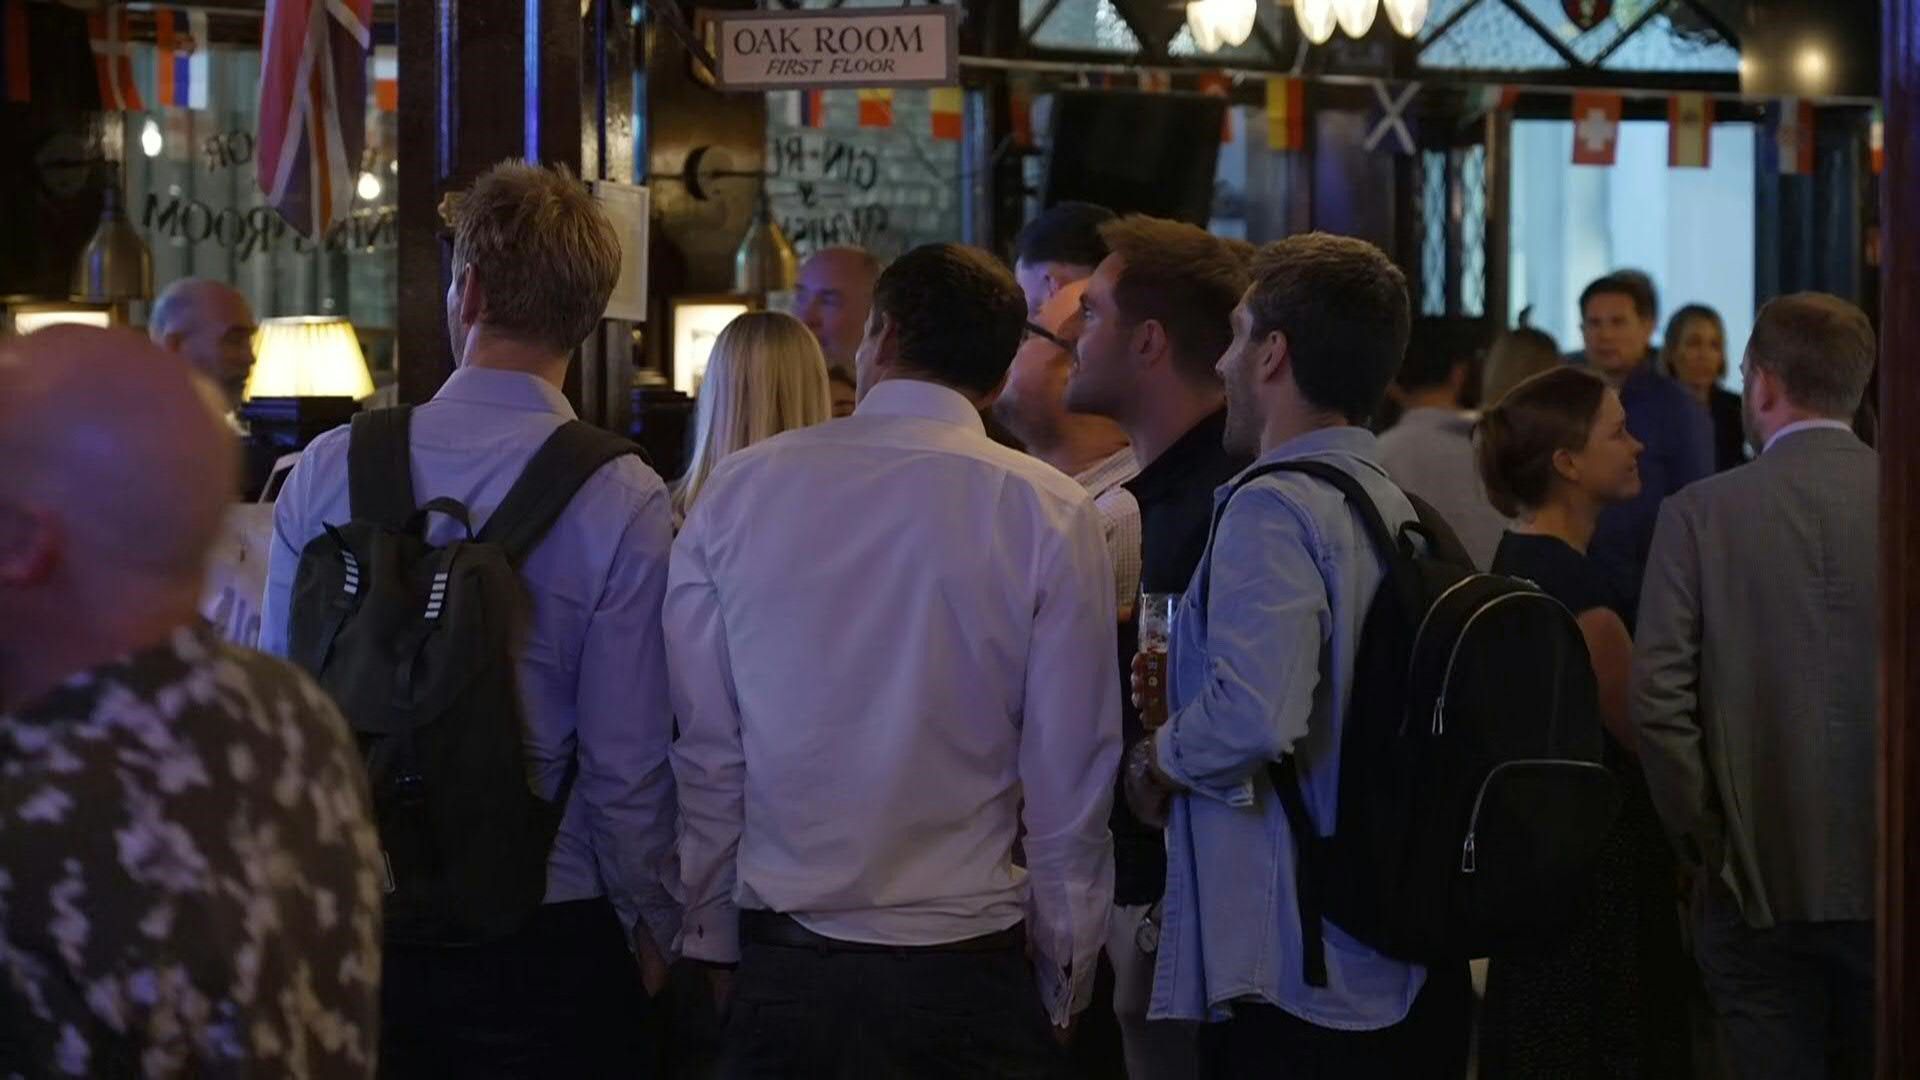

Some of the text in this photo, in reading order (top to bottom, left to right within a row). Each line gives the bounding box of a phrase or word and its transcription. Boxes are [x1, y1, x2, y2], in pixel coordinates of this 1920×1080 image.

[733, 24, 924, 55] OAK ROOM
[766, 57, 895, 76] FIRST FLOOR
